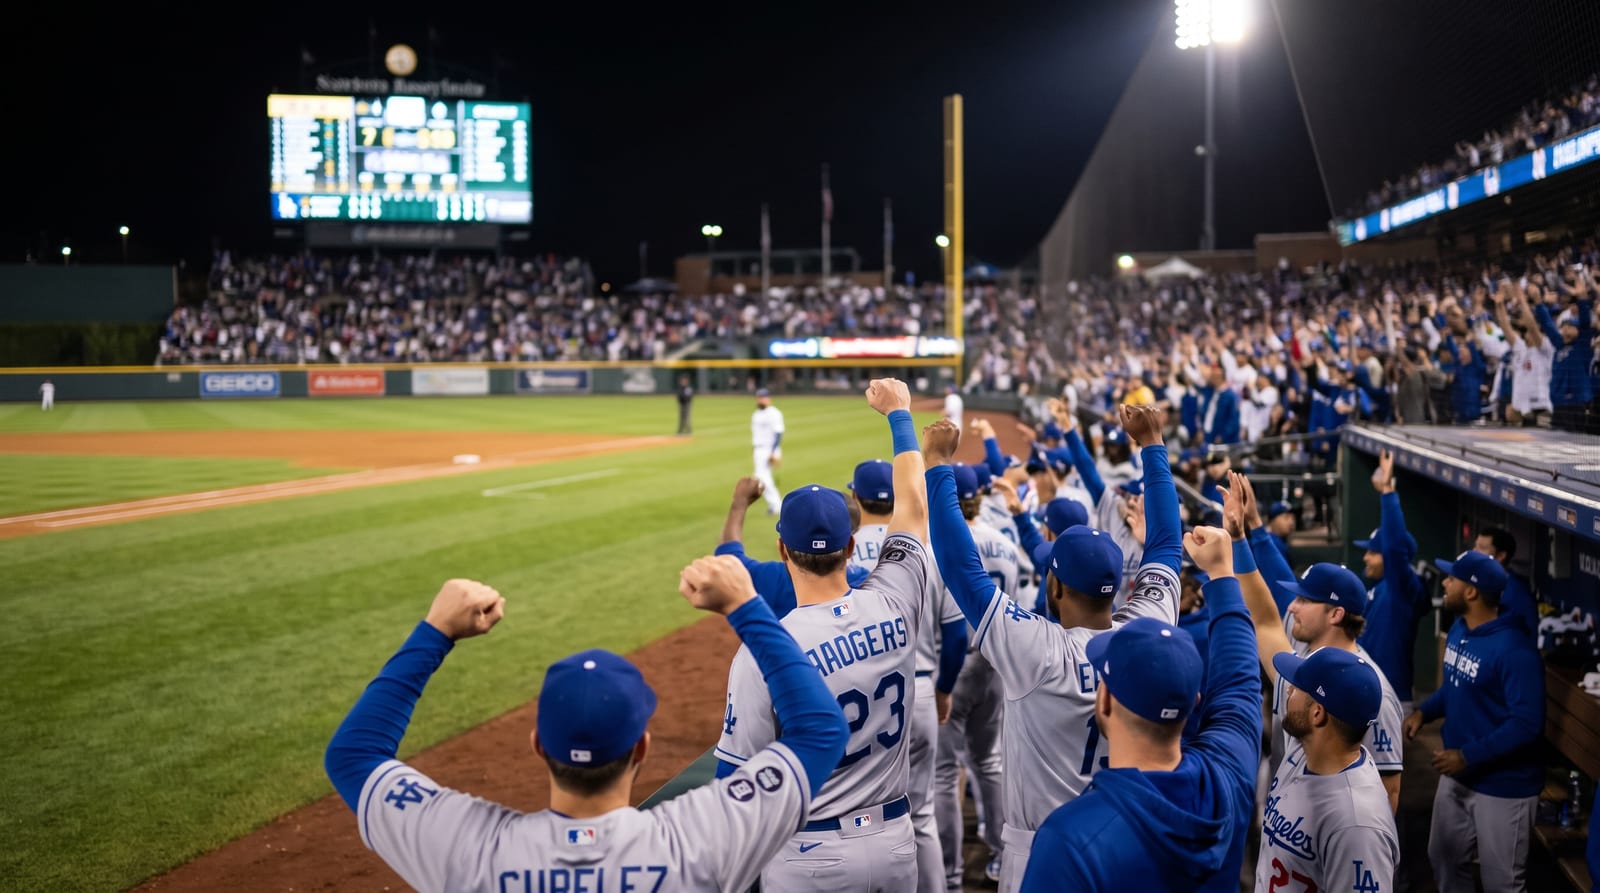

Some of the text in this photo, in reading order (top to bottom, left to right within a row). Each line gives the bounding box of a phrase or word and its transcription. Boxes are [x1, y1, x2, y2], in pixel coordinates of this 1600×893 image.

[205, 374, 274, 391] GEICO
[836, 671, 906, 769] 23
[1372, 722, 1393, 752] LA
[1352, 860, 1380, 893] LA
